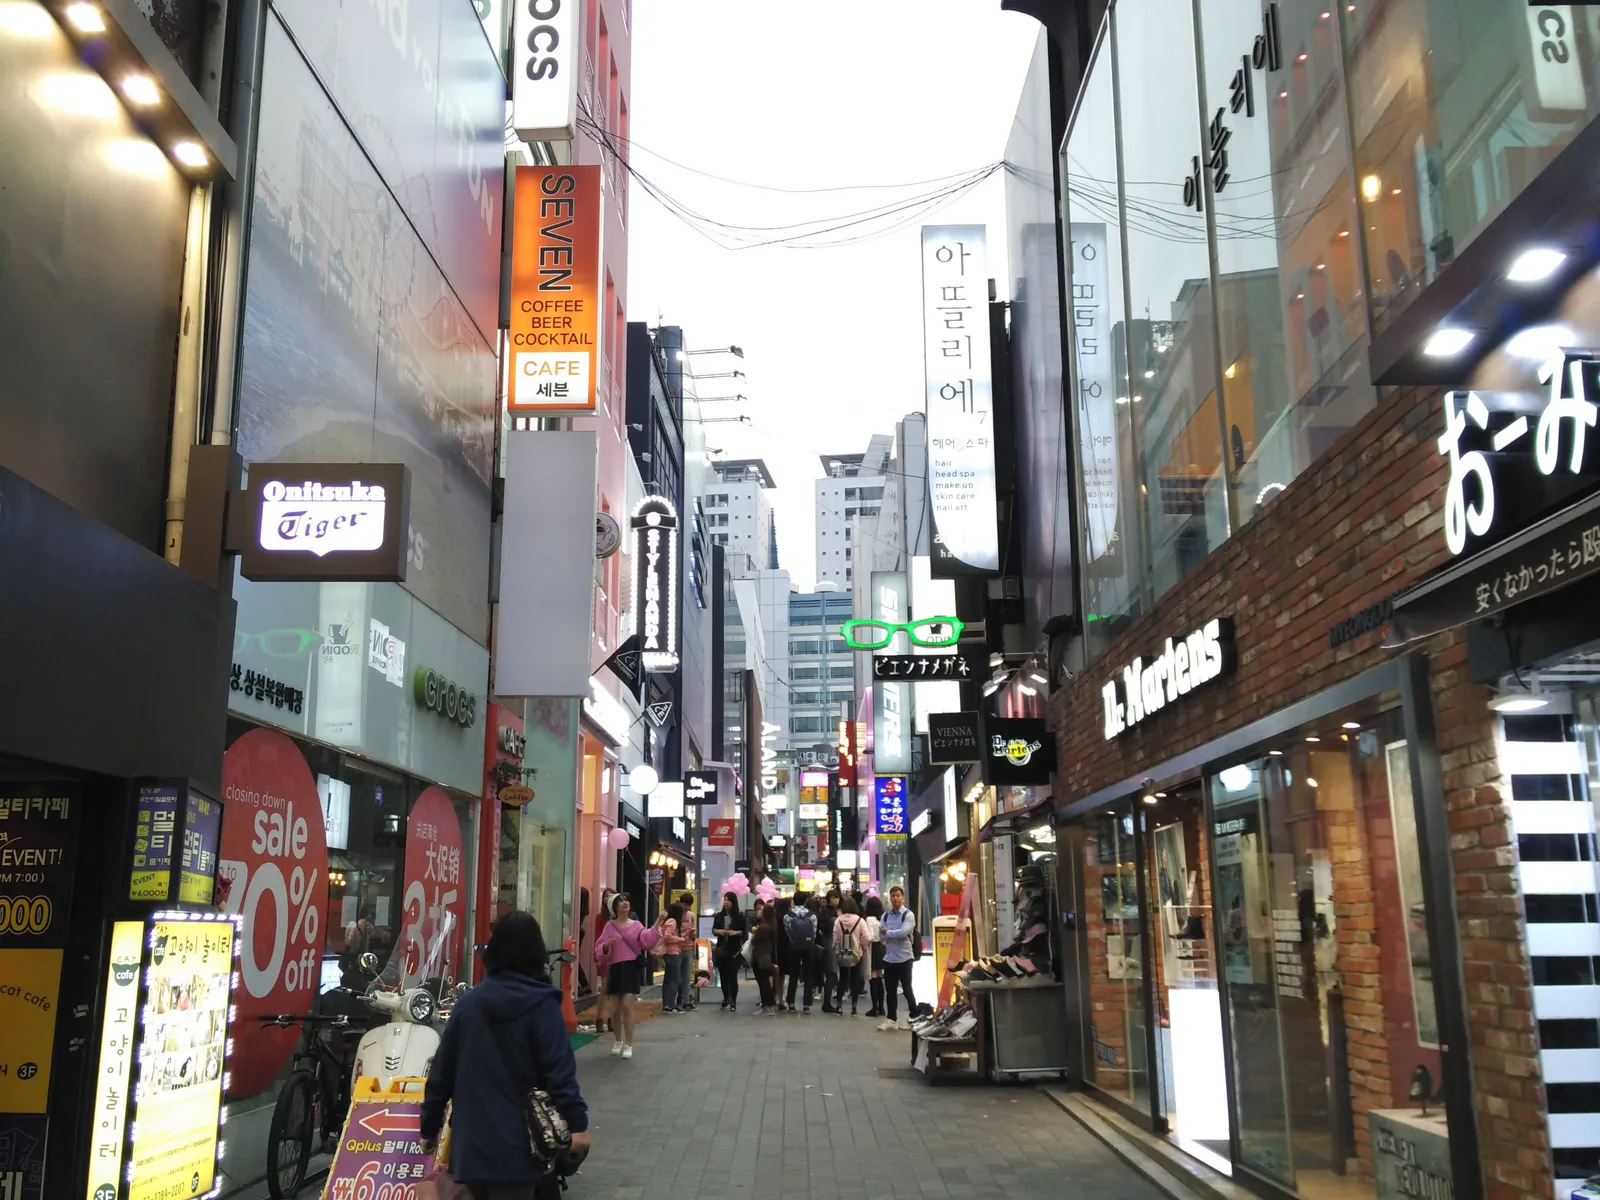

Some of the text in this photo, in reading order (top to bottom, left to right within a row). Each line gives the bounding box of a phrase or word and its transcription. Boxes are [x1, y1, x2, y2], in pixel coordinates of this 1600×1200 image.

[539, 174, 576, 292] SEVEN
[521, 300, 584, 313] COFFEE
[531, 316, 572, 329] BEER
[935, 241, 974, 414] 아뜰리에
[514, 332, 593, 346] COCKTAIL
[523, 360, 580, 376] CAFE
[536, 382, 569, 397] 세븐
[935, 459, 953, 467] hair
[935, 470, 976, 479] head spa
[263, 480, 386, 502] Onitsuka
[935, 481, 960, 489] make
[935, 493, 954, 501] skin
[936, 504, 953, 512] nail
[277, 510, 369, 541] Tiger
[874, 656, 971, 677] ビエンナメガネ
[1123, 617, 1222, 727] Martens
[424, 668, 476, 729] crocs
[936, 726, 973, 737] VIENNA
[993, 740, 1042, 757] Martens
[226, 784, 286, 810] closing down
[151, 810, 176, 857] 멀티
[252, 801, 308, 860] sale
[1, 848, 63, 867] EVENT!
[424, 842, 461, 885] 大促销
[15, 872, 38, 883] 7:00
[133, 873, 156, 886] EVENT
[116, 970, 134, 980] cafe
[285, 949, 315, 992] off
[24, 990, 51, 1013] cafe
[19, 1065, 37, 1078] 3F
[346, 1139, 381, 1153] Qplus
[383, 1139, 408, 1155] 멀티
[383, 1162, 424, 1179] 이용료
